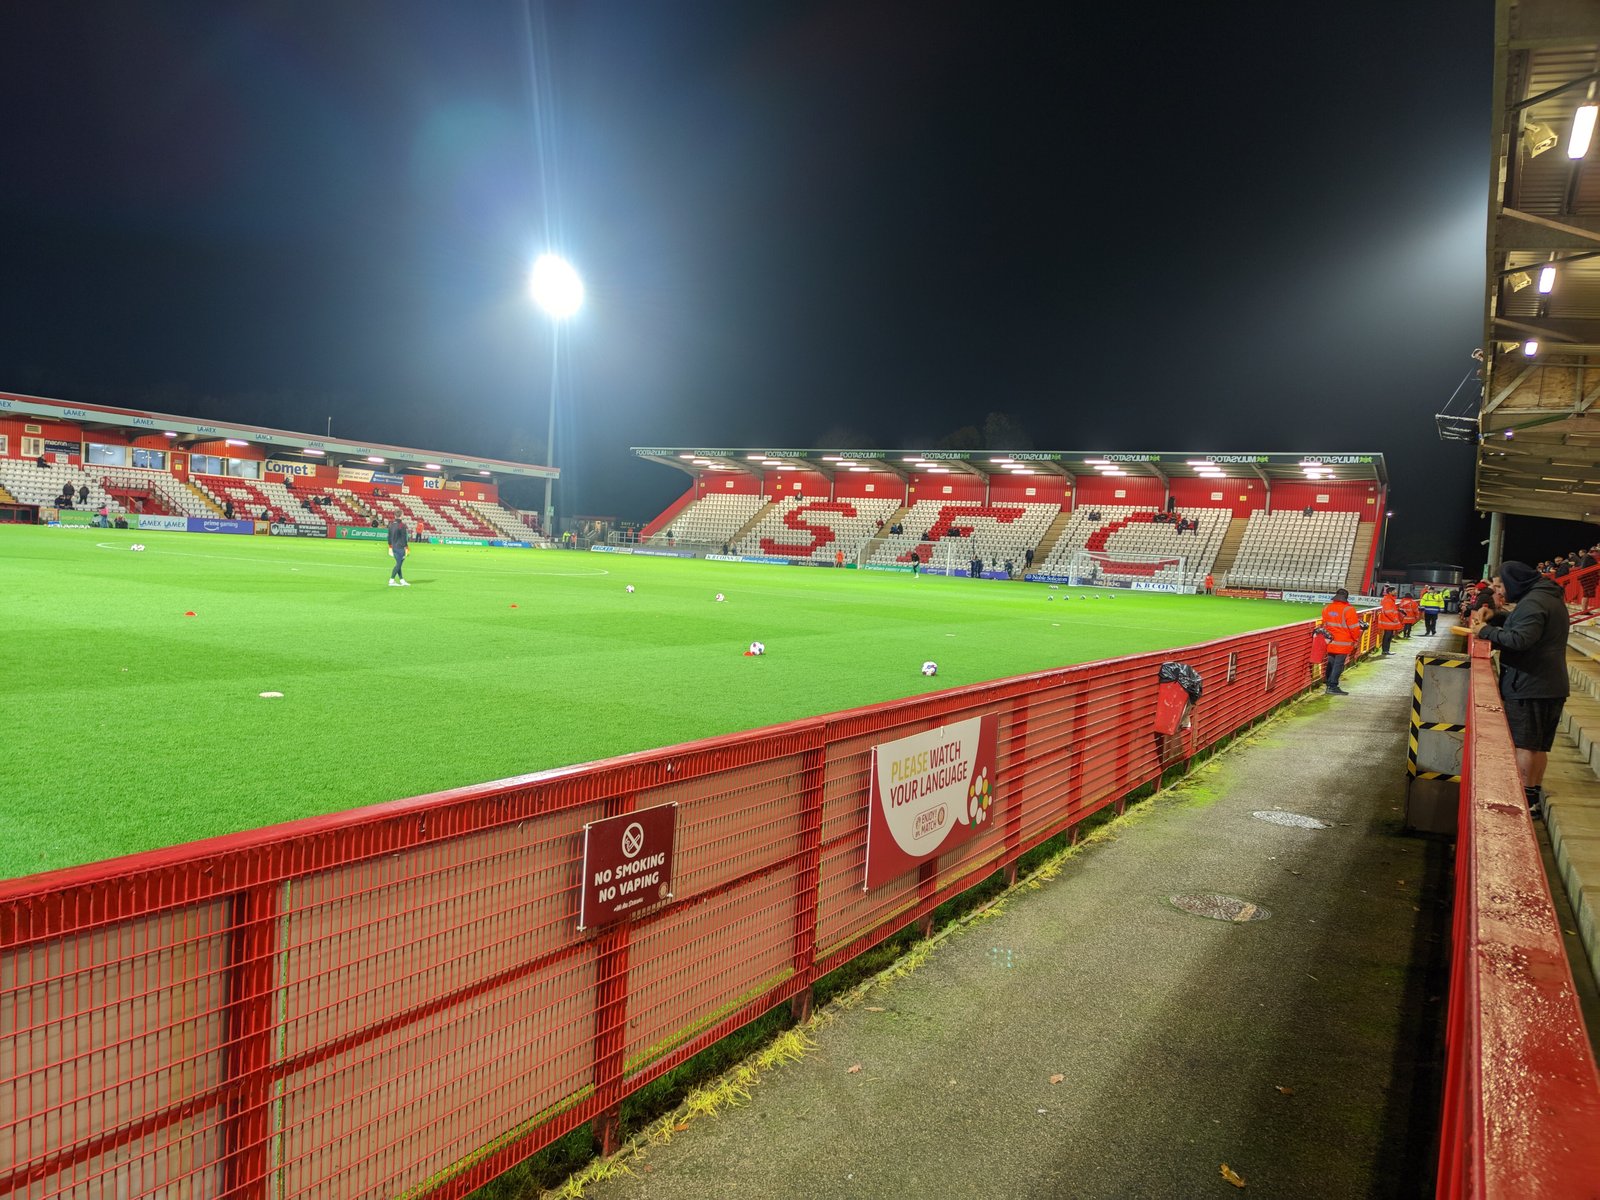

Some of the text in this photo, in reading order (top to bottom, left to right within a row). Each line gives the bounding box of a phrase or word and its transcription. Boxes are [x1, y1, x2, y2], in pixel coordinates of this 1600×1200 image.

[63, 409, 86, 417] LAMEX
[133, 418, 154, 426] LAMEX
[266, 460, 308, 475] Comet
[892, 740, 961, 783] PLEASE WATCH
[890, 761, 968, 808] YOUR LANGUAGE
[921, 820, 936, 835] MATCH
[594, 852, 665, 886] NO SMOKING
[599, 871, 659, 903] NO VAPING
